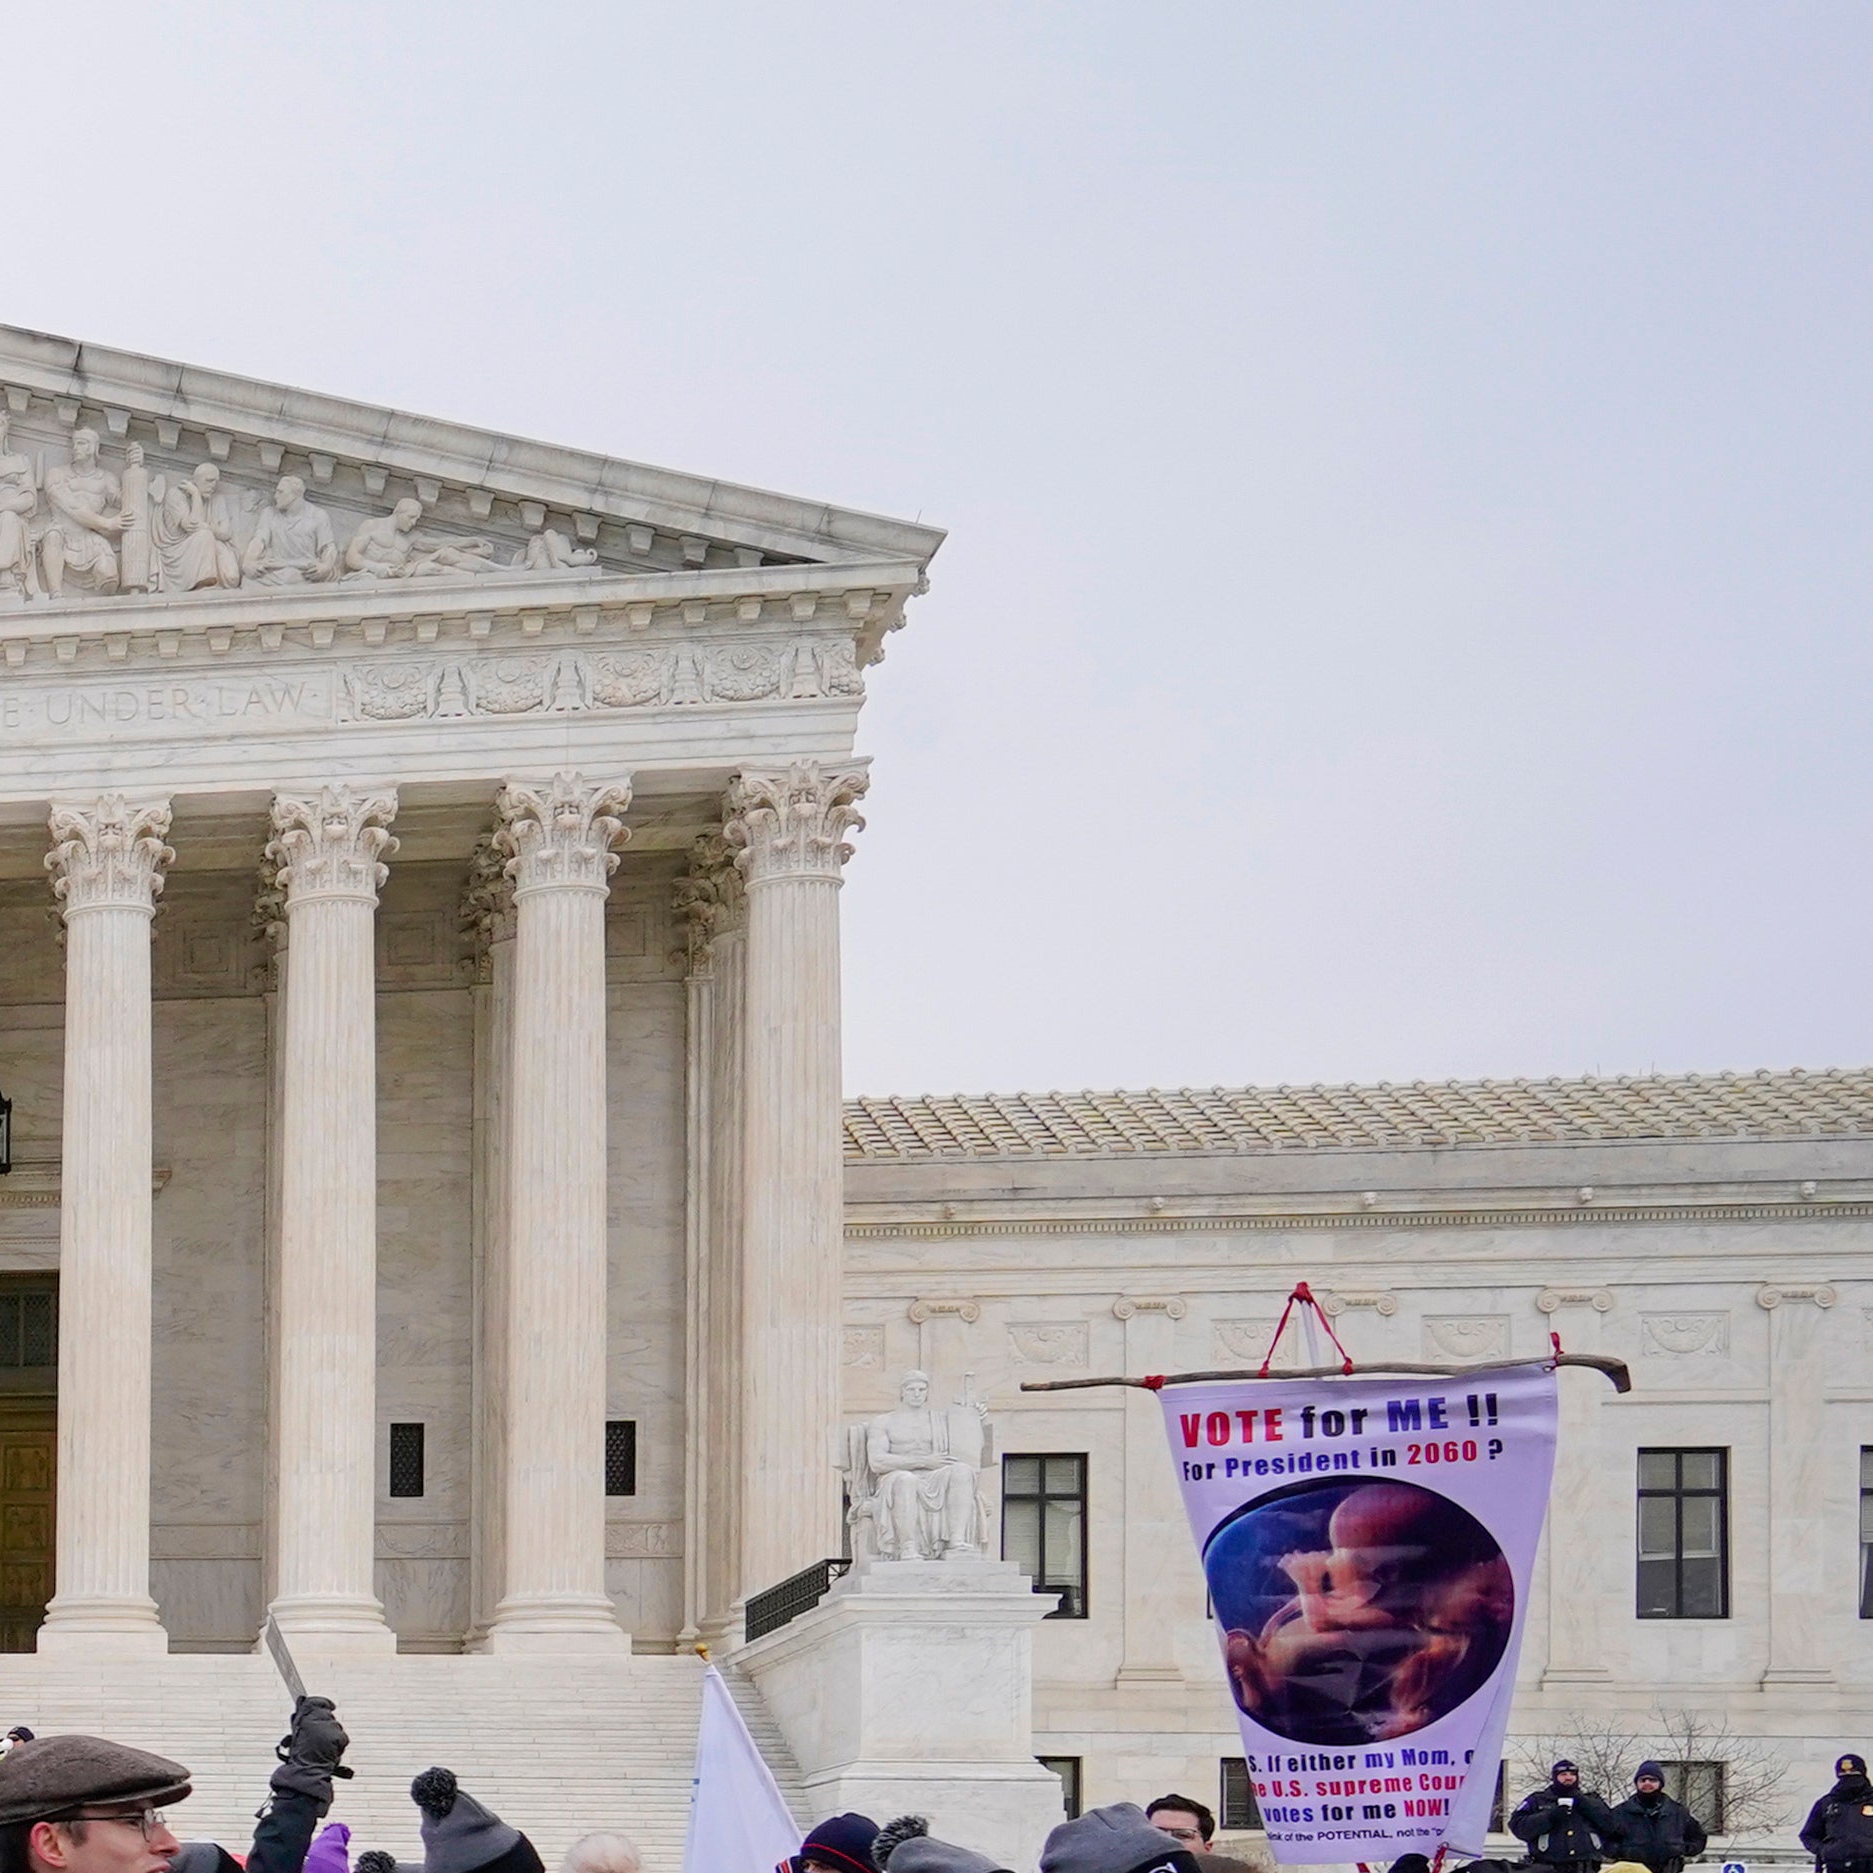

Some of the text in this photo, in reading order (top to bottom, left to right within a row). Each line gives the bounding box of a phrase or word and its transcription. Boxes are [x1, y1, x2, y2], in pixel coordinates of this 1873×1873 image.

[45, 689, 195, 726] UNDER
[217, 681, 307, 718] LAW
[1180, 1393, 1498, 1448] VOTE for ME !!
[1183, 1438, 1503, 1482] For President in 2060 ?
[1267, 1755, 1281, 1773] If
[1287, 1753, 1356, 1773] either
[1365, 1752, 1394, 1769] my
[1402, 1748, 1455, 1767] Mom,
[1272, 1780, 1308, 1798] U.S.
[1316, 1776, 1412, 1797] supreme
[1263, 1798, 1450, 1823] votes for me NOW!
[1317, 1829, 1393, 1841] POTENTIAL,
